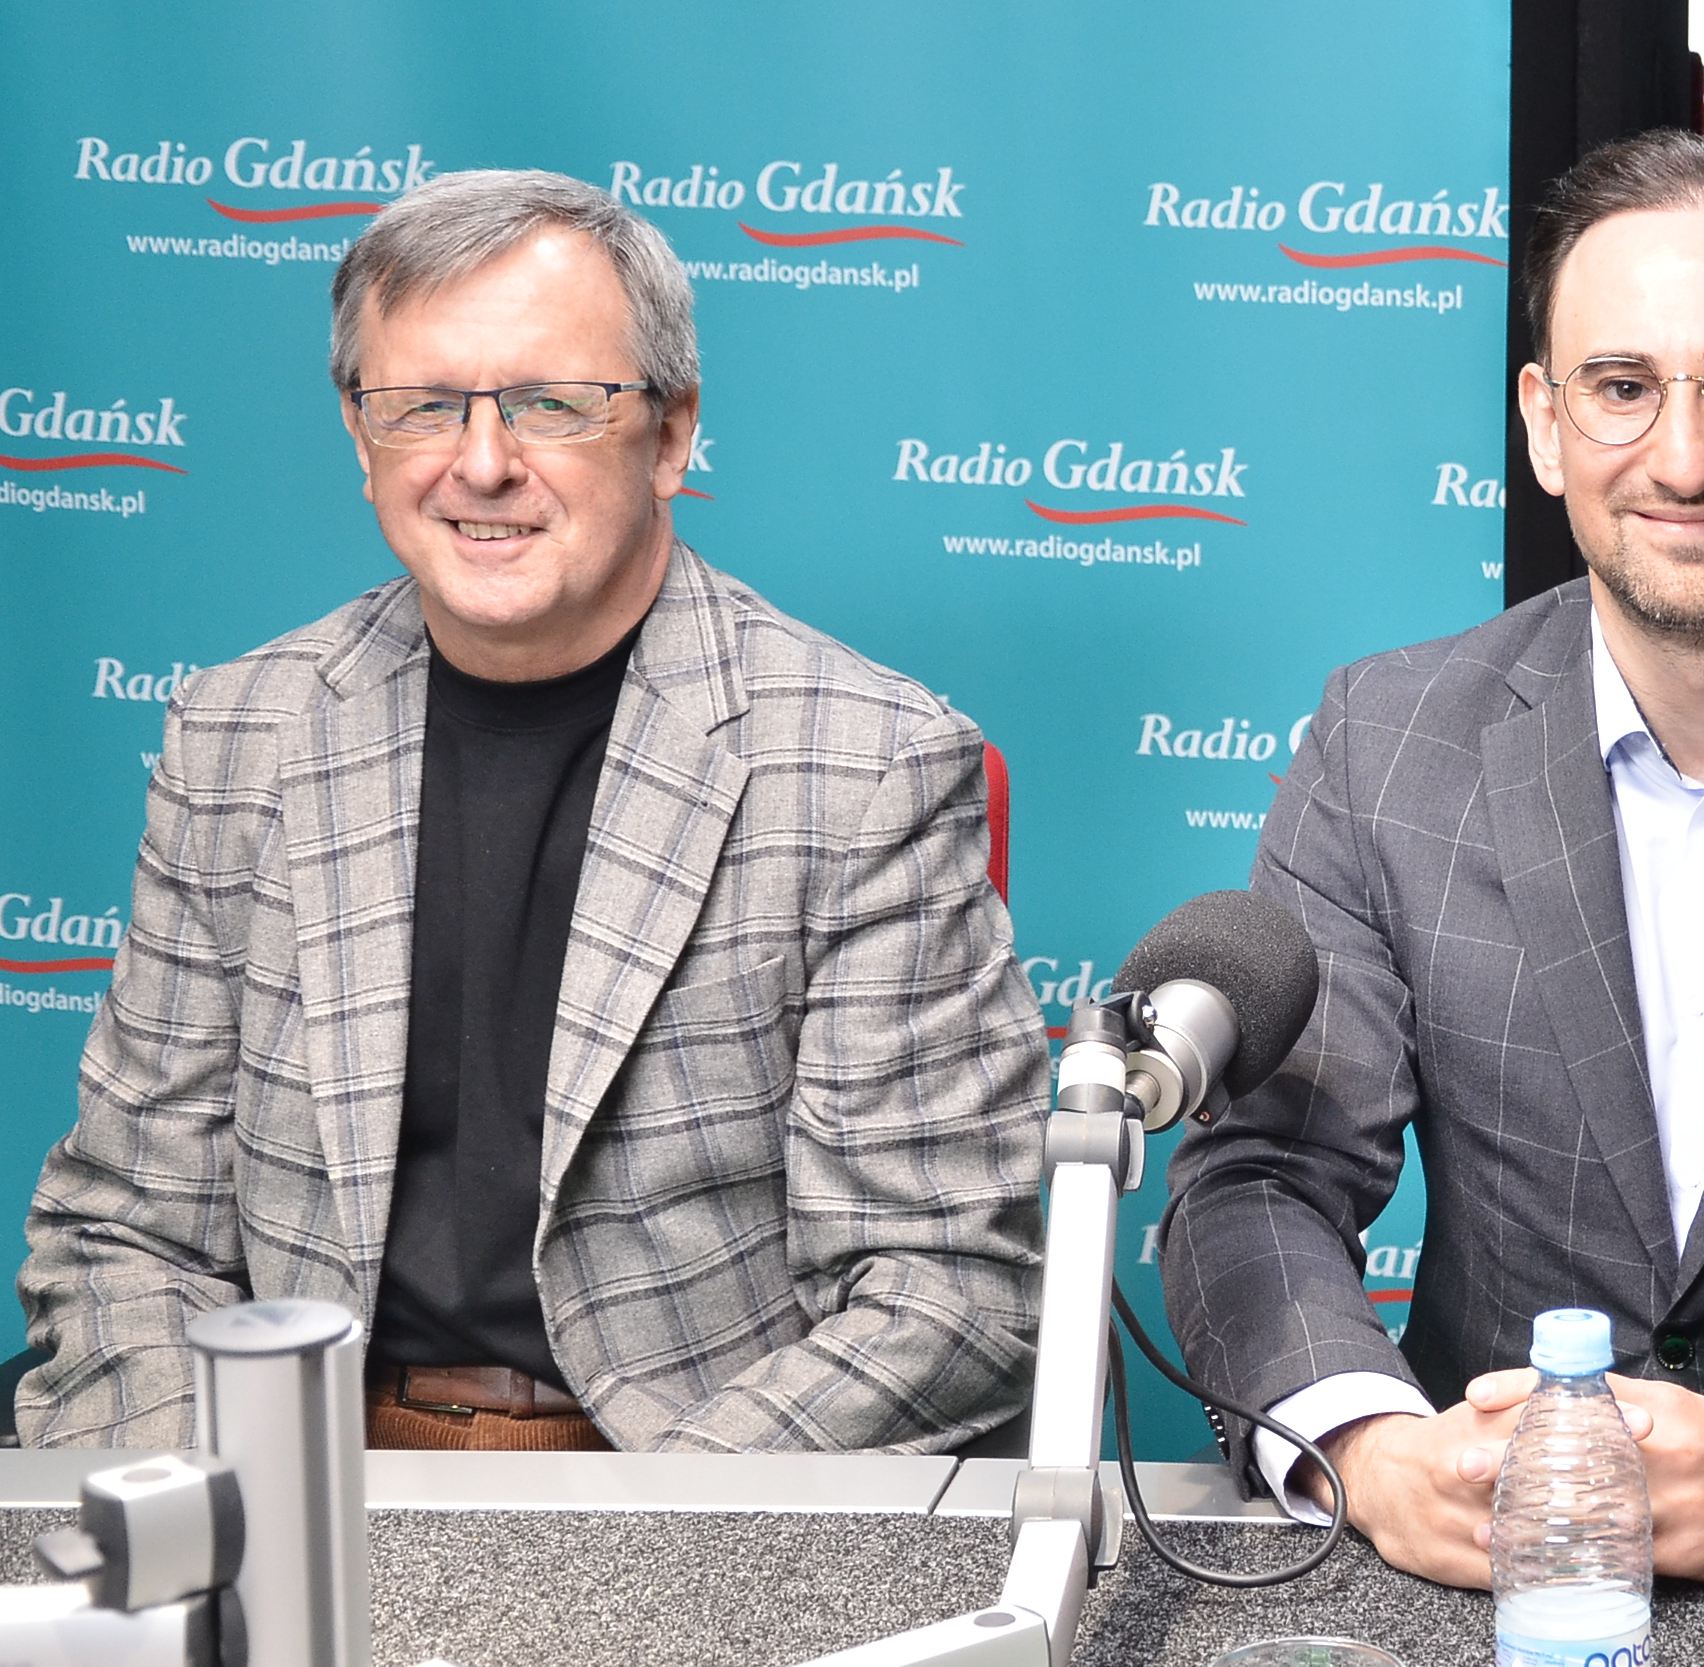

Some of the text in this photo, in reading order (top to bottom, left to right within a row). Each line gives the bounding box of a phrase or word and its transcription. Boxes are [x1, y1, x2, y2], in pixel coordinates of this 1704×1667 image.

[73, 136, 436, 193] Radio Gdańsk
[609, 160, 966, 218] Radio Gdańsk
[1142, 180, 1509, 239] Radio Gdańsk
[1193, 280, 1463, 315] www.radiogdansk.pl
[0, 387, 188, 447] Gdańsk
[891, 437, 1249, 498] Radio Gdańsk
[942, 535, 1201, 572] www.radiogdansk.pl
[1135, 712, 1277, 762] Radio
